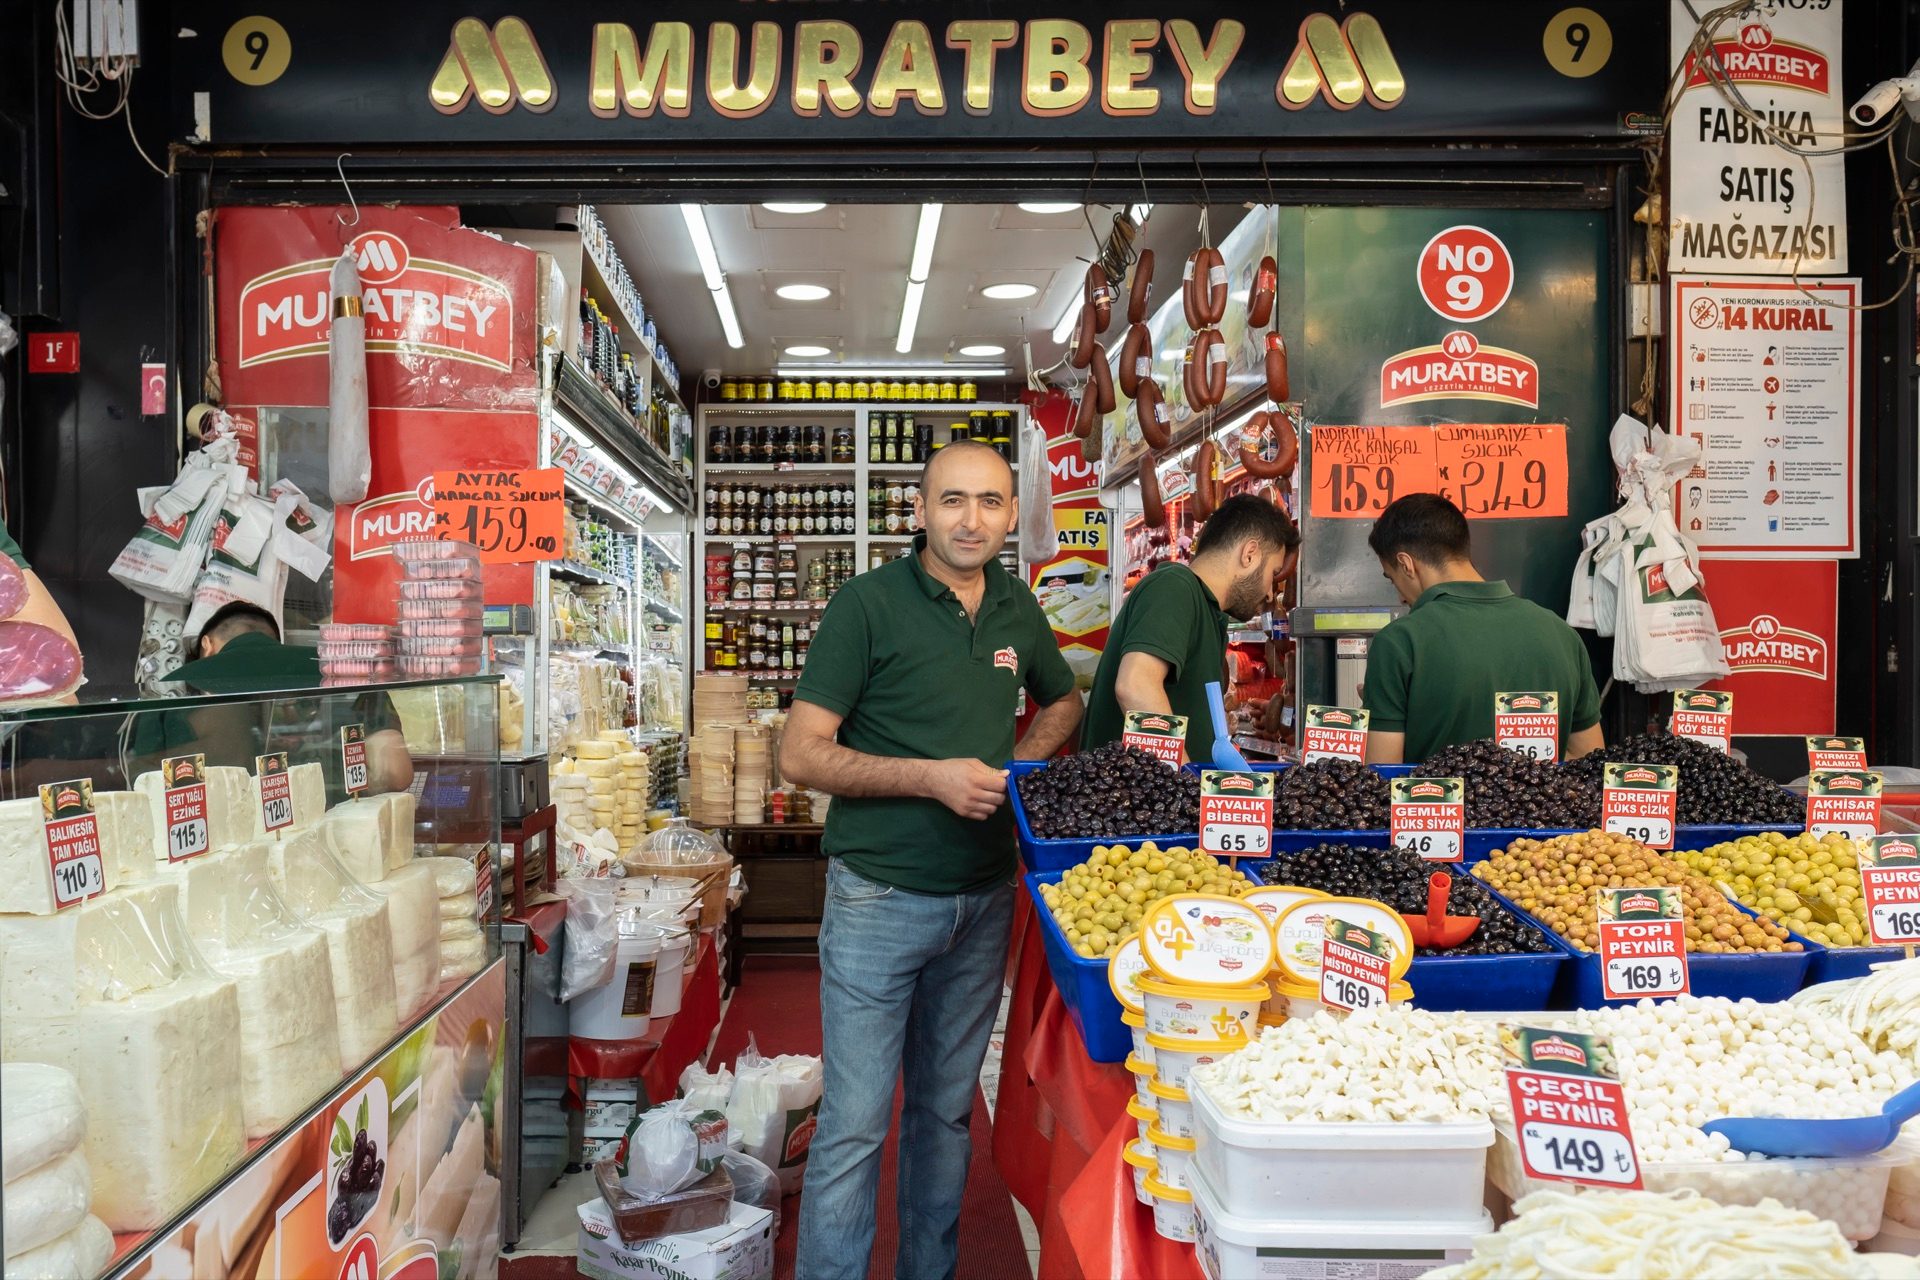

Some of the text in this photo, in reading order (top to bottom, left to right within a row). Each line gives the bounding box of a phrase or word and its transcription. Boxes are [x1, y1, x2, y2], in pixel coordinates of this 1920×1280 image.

[245, 31, 269, 70] 9
[1565, 23, 1591, 62] 9
[589, 19, 1246, 118] MURATBEY
[1699, 99, 1818, 146] FABRİKA
[1719, 166, 1795, 214] SATIŞ
[1682, 215, 1837, 260] MAĞAZASI
[1438, 244, 1494, 272] NO
[1446, 275, 1484, 311] 9
[257, 288, 497, 338] MUATBEY
[1752, 308, 1833, 332] KURAL
[1391, 361, 1529, 390] MURATBEY
[1424, 383, 1496, 393] LEZZETİN TARİFİ
[1438, 427, 1546, 442] CUMHURİYET
[1366, 440, 1422, 454] KANGAL
[1461, 444, 1522, 459] SUCUK
[1343, 453, 1400, 465] SUCUK
[435, 490, 503, 501] KANGAL
[1318, 463, 1396, 513] 159
[1460, 460, 1547, 514] 249
[458, 504, 557, 553] 159.00
[1057, 530, 1100, 548] ATIŞ
[1500, 717, 1557, 726] MUDANYA
[1676, 714, 1728, 724] GEMLİK
[1307, 730, 1364, 743] GEMLİK İRİ
[1498, 727, 1556, 737] AZ TUZLU
[1677, 723, 1726, 736] KÖY SELE
[1125, 735, 1181, 749] KERAMET KÖY
[1307, 739, 1362, 754] SİYAH
[1515, 744, 1538, 760] 56
[262, 776, 288, 788] KARIŞIK
[350, 765, 363, 785] 135
[168, 788, 204, 808] SERT YAĞLI
[1206, 799, 1265, 811] AYVALIK
[1608, 791, 1670, 804] EDREMİT
[1813, 799, 1876, 810] AKHİSAR
[172, 805, 201, 821] EZİNE
[269, 800, 286, 823] 120
[1206, 811, 1266, 824] BİBERLİ
[1395, 806, 1458, 817] GEMLİK
[1607, 802, 1670, 817] LÜKS ÇİZİK
[1811, 809, 1874, 821] İRİ KIRMA
[49, 818, 95, 843] BALIKESİR
[1394, 817, 1460, 829] LÜKS SİYAH
[176, 824, 196, 850] 115
[1220, 834, 1246, 851] 65
[1407, 836, 1433, 852] 46
[1626, 827, 1650, 845] 59
[52, 836, 98, 862] TAM YAĞLI
[63, 862, 87, 895] 110
[1870, 871, 1920, 883] BURG
[1612, 922, 1672, 937] TOPİ
[1888, 912, 1920, 936] 169
[1609, 938, 1676, 955] PEYNİR
[1328, 942, 1385, 971] MURATBEY
[1324, 956, 1387, 987] MİSTO PEYNİR
[1621, 966, 1662, 990] 169
[1335, 979, 1370, 1009] 169
[1516, 1076, 1616, 1103] ÇEÇİL
[1522, 1098, 1619, 1127] PEYNİR
[1544, 1137, 1605, 1174] 149
[610, 1251, 645, 1272] Kaşar
